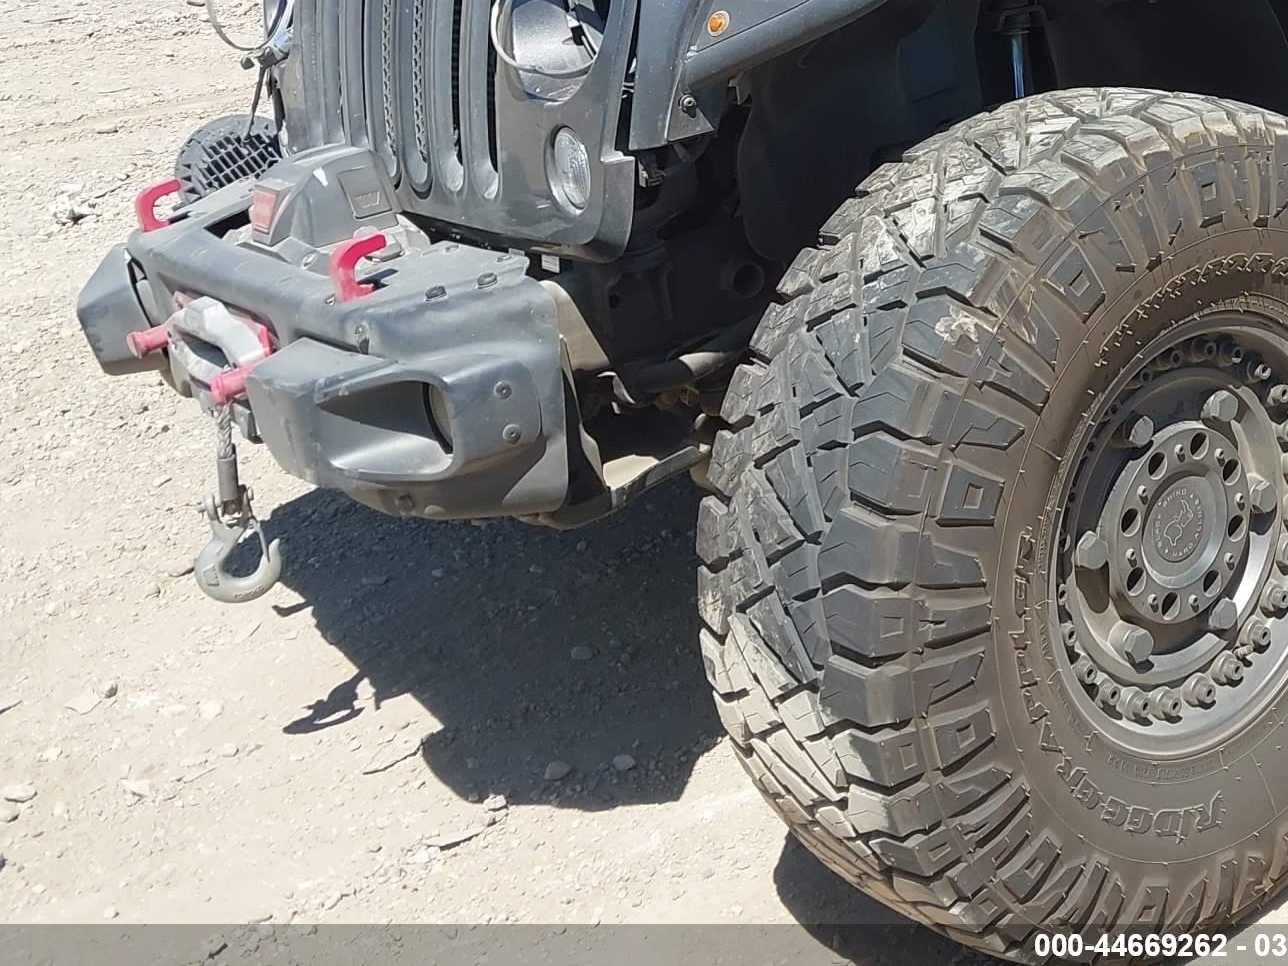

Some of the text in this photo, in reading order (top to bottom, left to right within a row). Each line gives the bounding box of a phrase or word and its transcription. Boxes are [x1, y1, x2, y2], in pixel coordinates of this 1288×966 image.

[1162, 489, 1187, 508] RHINO
[1173, 541, 1195, 556] HARD
[1007, 531, 1103, 811] GRAPPLER
[1101, 790, 1224, 844] RIDGE
